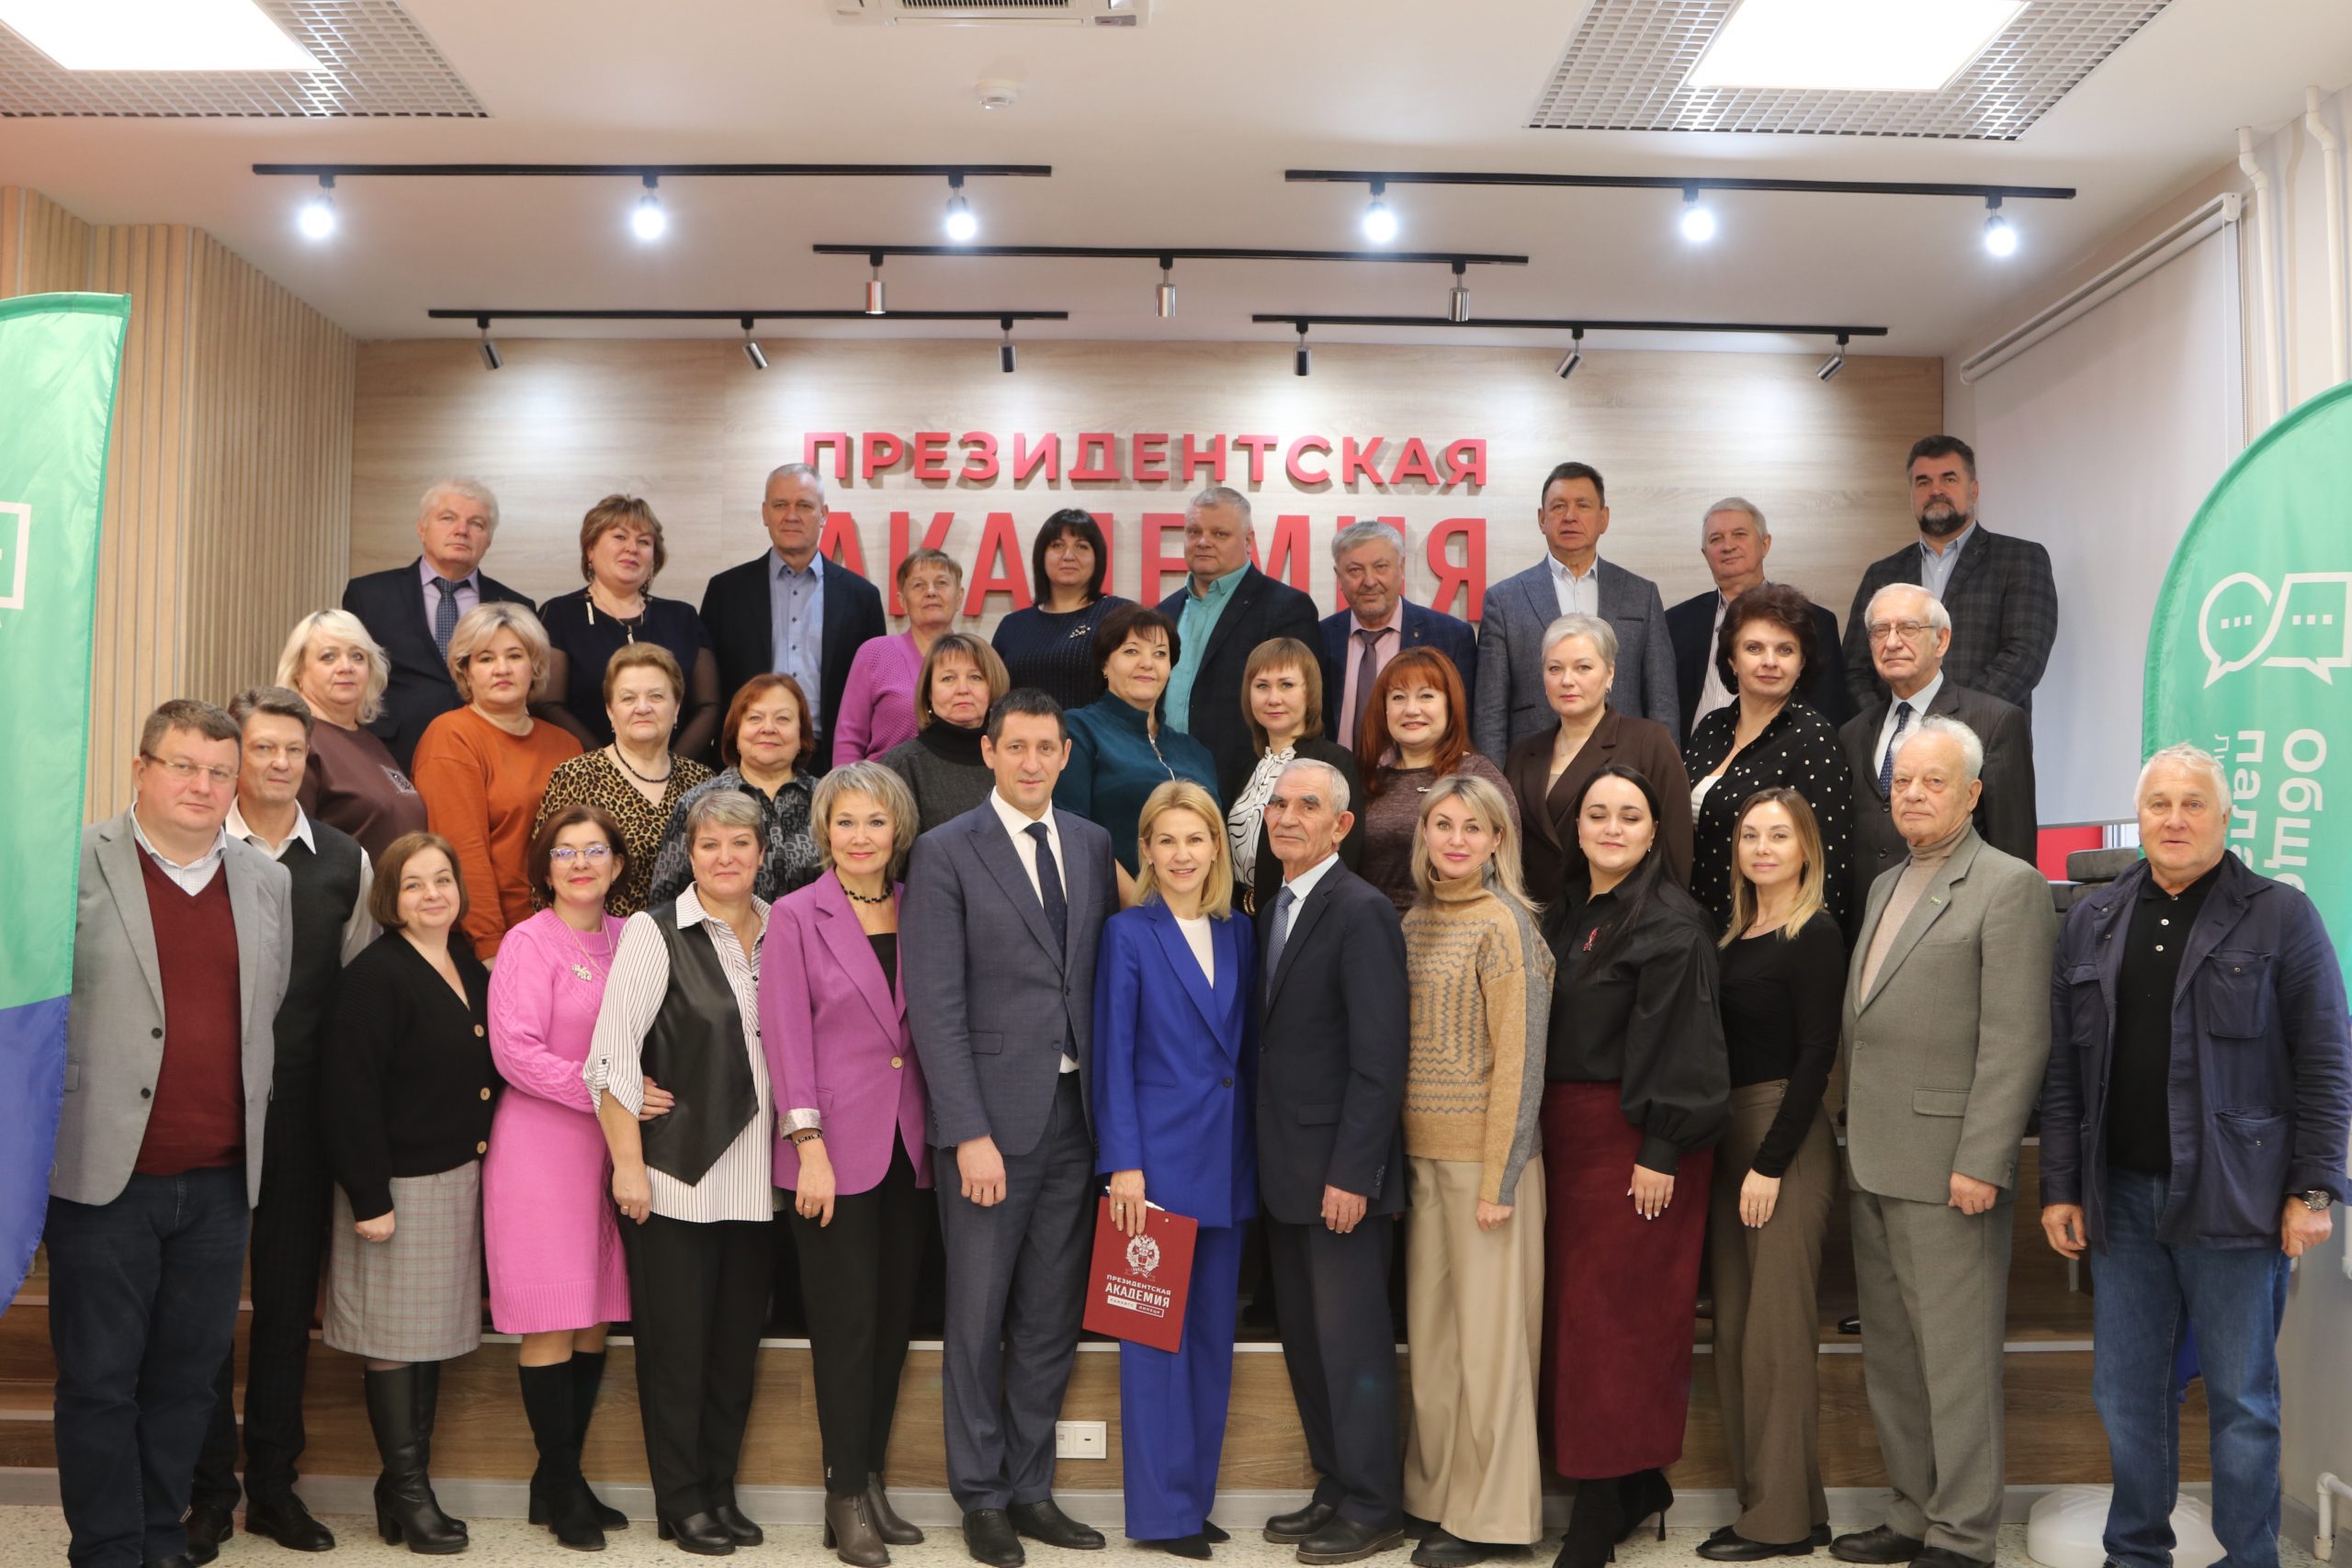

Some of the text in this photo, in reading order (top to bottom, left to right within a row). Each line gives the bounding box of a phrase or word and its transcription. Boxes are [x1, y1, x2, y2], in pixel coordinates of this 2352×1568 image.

[804, 431, 1487, 486] ПРЕЗИДЕНТСКАЯ
[1105, 1282, 1170, 1308] АКАДЕМИЯ
[1106, 1274, 1171, 1295] ПРЕЗИДЕНТСКАЯ
